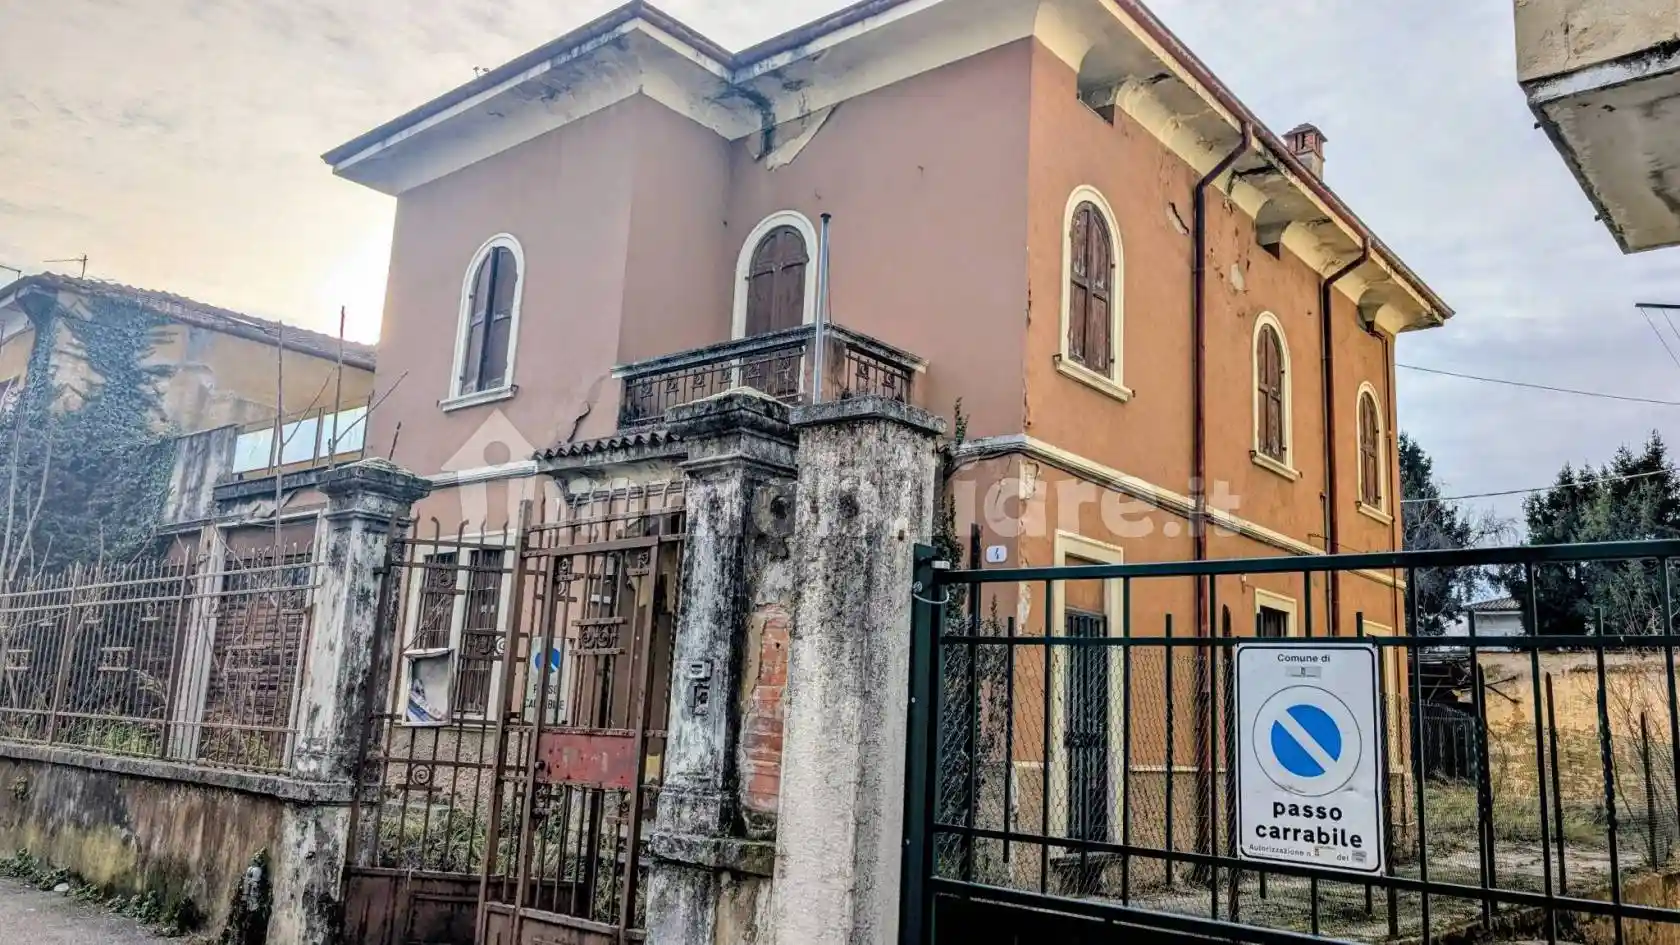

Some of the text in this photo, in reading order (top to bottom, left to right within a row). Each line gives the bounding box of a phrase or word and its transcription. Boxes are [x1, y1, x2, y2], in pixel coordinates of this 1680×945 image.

[1277, 653, 1331, 663] Comune di
[1272, 801, 1343, 821] passo
[1255, 824, 1363, 849] carrabile
[1249, 843, 1305, 857] Autorizzazione
[1336, 853, 1350, 862] del
